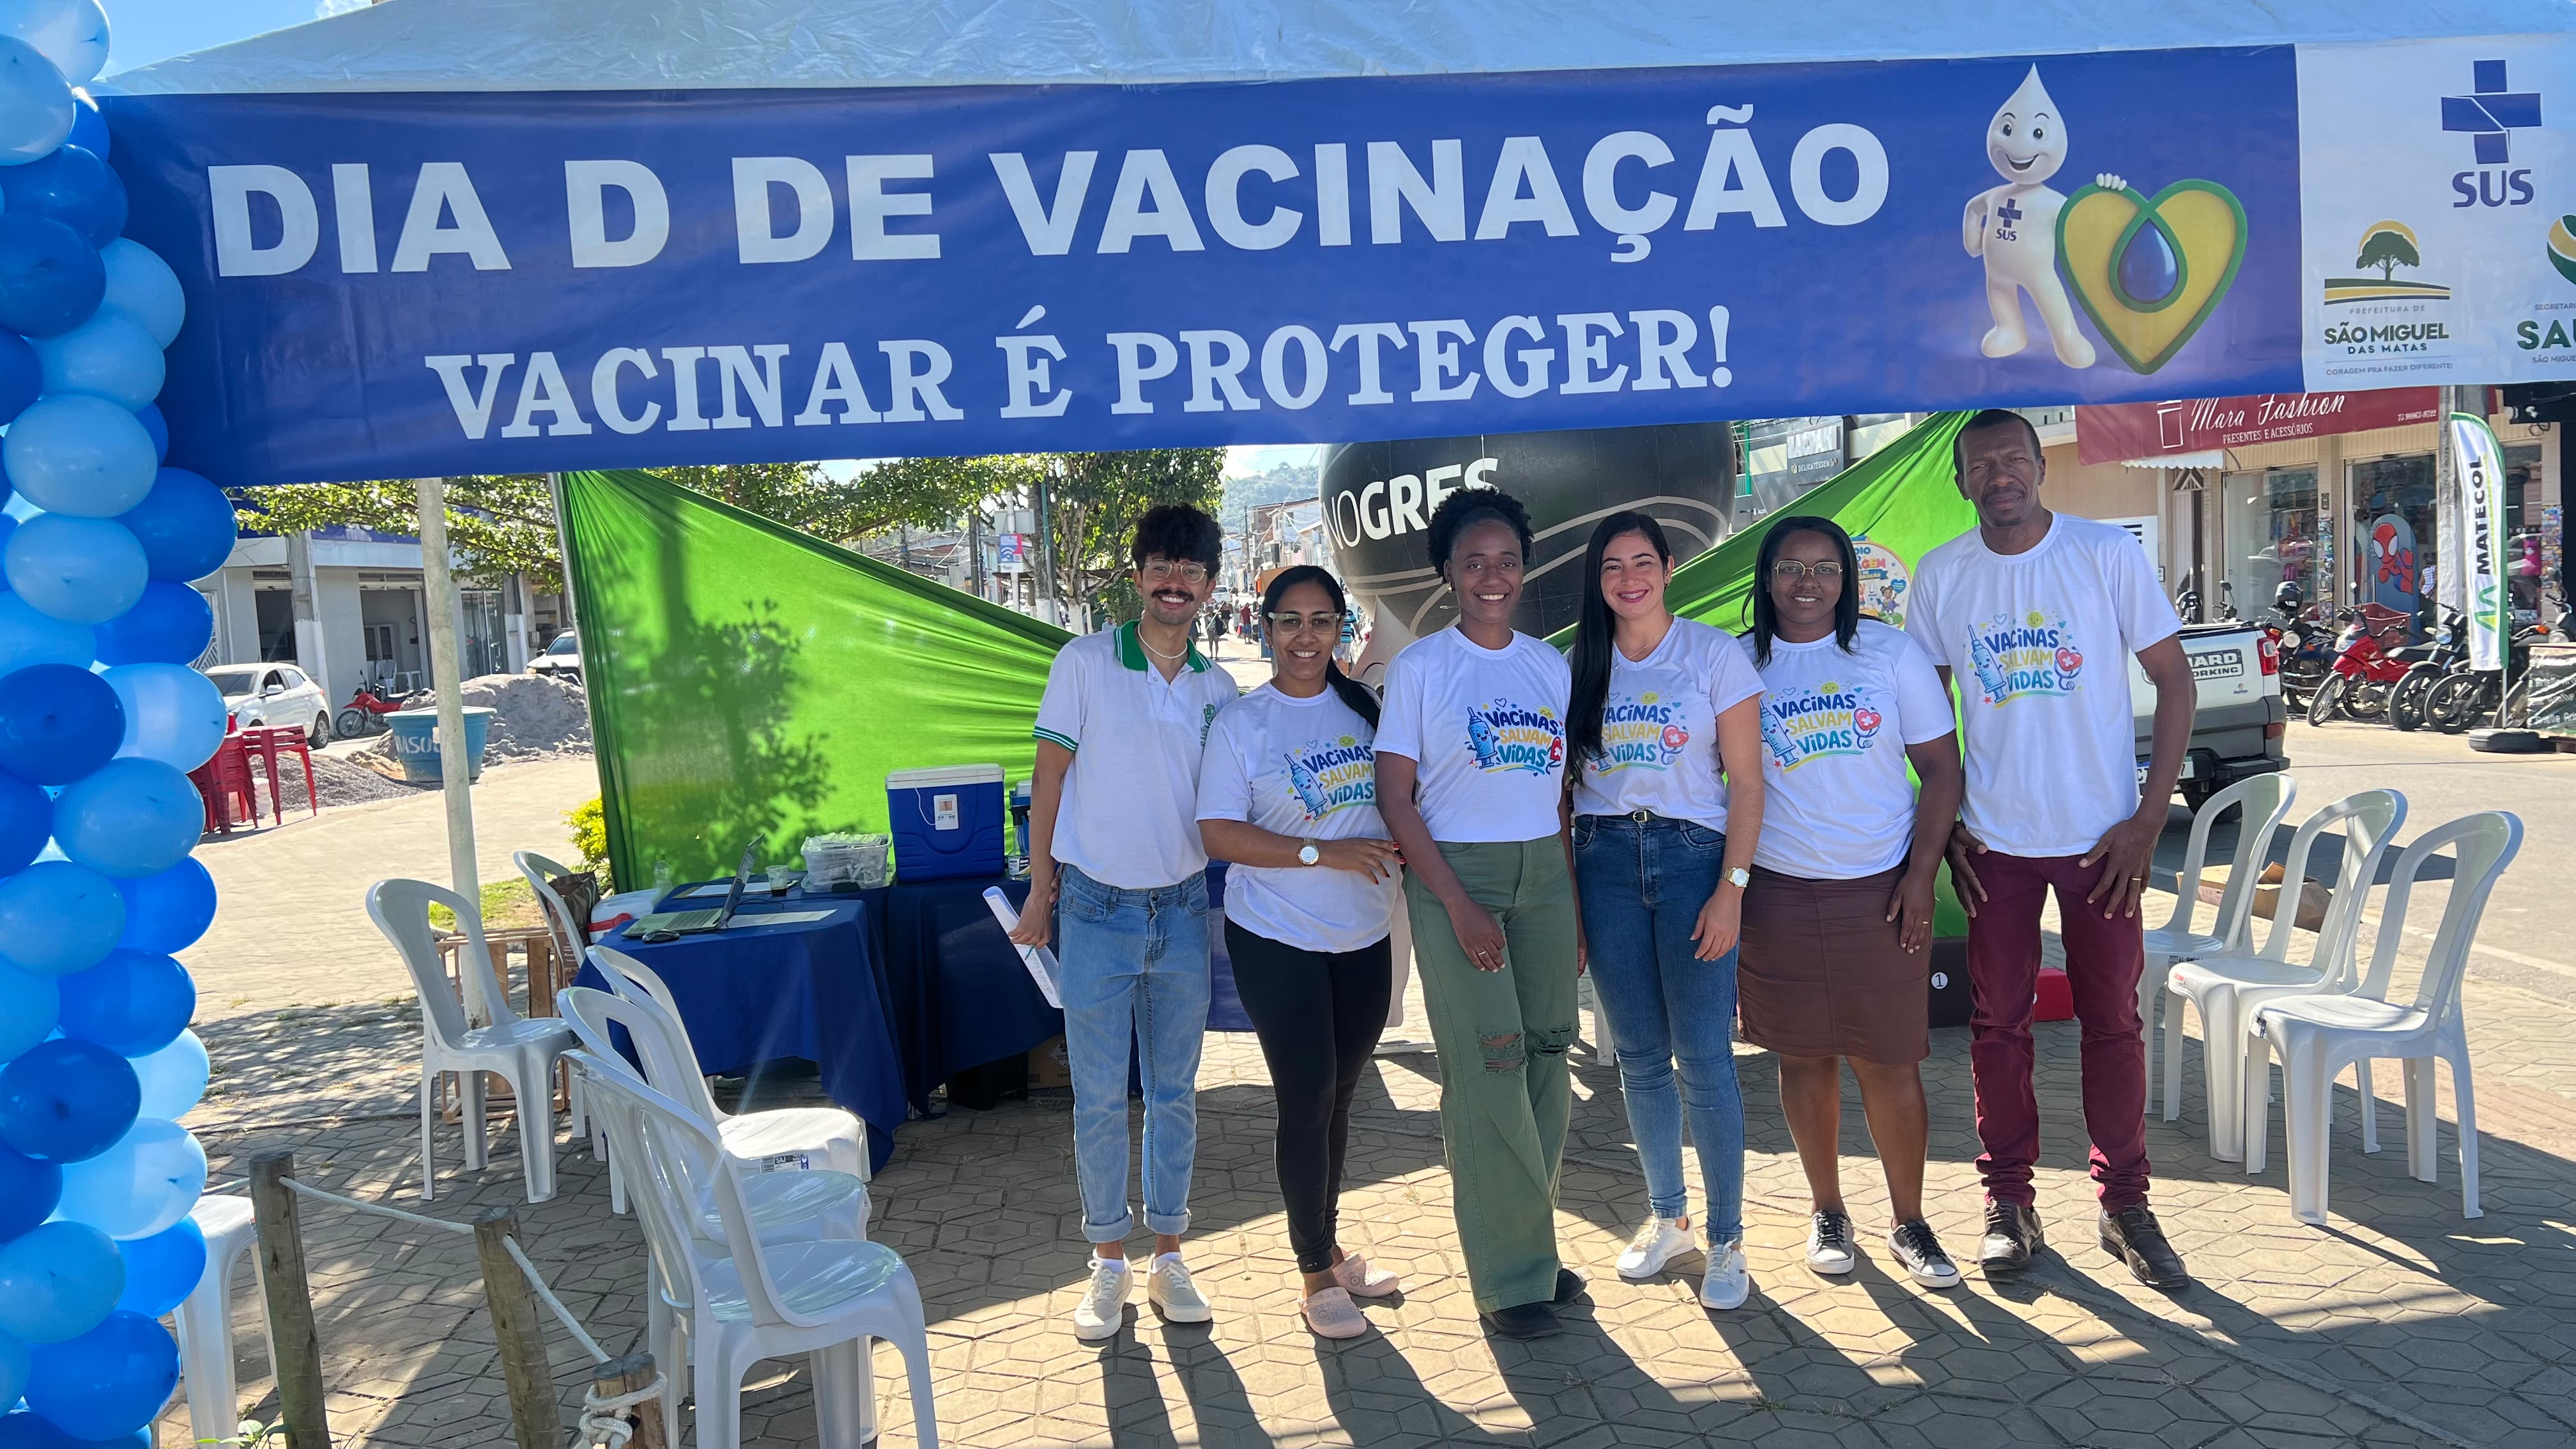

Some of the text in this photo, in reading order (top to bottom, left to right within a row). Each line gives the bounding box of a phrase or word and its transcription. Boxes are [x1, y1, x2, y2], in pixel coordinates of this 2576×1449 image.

[207, 103, 1889, 277] DIA D DE VACINAÇÃO
[2452, 169, 2534, 208] SUS
[1995, 228, 2017, 241] SUS
[2350, 306, 2409, 314] PREFEITURA
[2324, 321, 2450, 344] SÃO MIGUEL
[2517, 319, 2576, 350] SA
[2347, 343, 2427, 354] DAS MATAS
[2533, 355, 2549, 364] SÃO
[425, 305, 1733, 440] VACINAR É PROTEGER!
[2190, 392, 2345, 431] Mara Fashion
[2223, 422, 2313, 444] PRESENTES E ACESSÓRIOS
[1798, 459, 1830, 472] DELICATESSEN
[2469, 456, 2490, 575] MATECOL
[1999, 649, 2053, 671] SALVAM
[1602, 723, 1660, 742] SALVAM
[1786, 711, 1851, 735] SALVAM
[1498, 728, 1552, 748] SALVAM
[1319, 763, 1374, 789] SALVAM
[1935, 974, 1943, 987] 1
